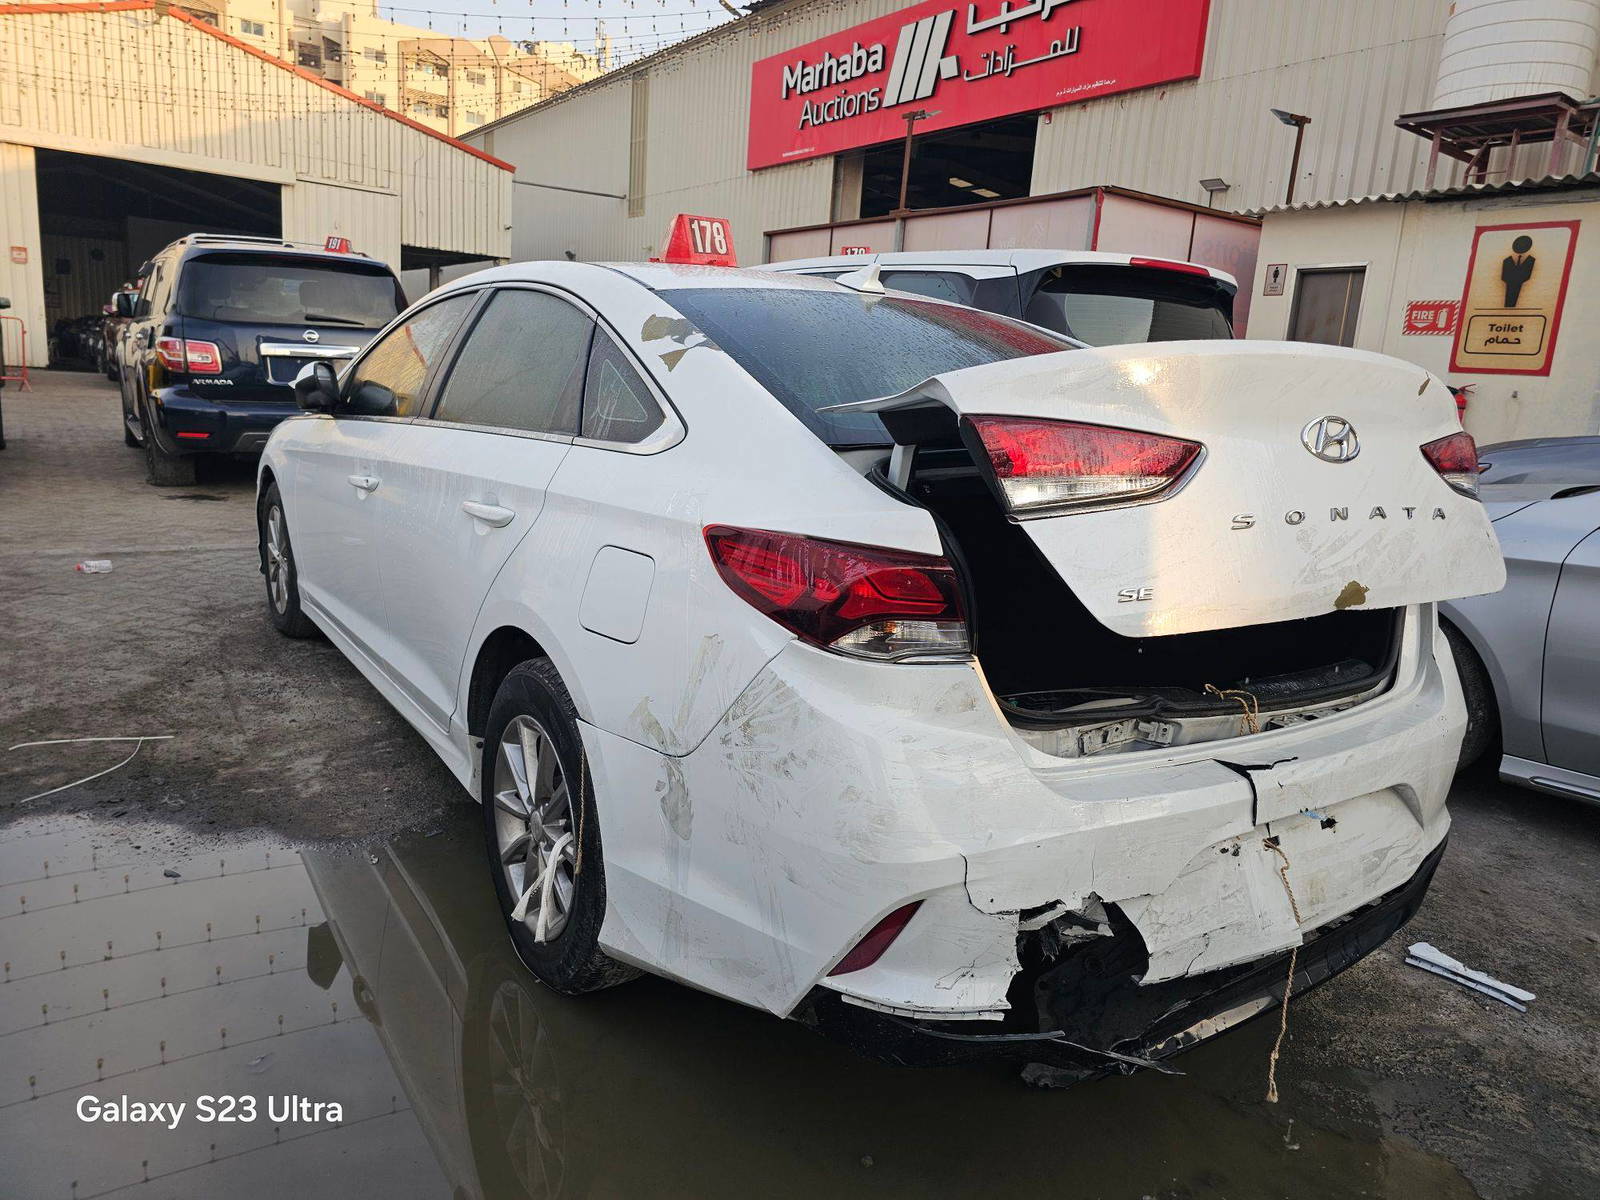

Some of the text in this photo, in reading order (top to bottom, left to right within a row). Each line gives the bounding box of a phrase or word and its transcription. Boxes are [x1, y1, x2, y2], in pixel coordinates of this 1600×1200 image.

[782, 42, 884, 99] Marhaba
[799, 87, 880, 129] Auctions
[328, 237, 341, 249] 191
[691, 219, 727, 254] 178
[1411, 310, 1435, 321] FIRE
[1488, 323, 1524, 333] Toilet
[1484, 335, 1522, 347] حمام
[191, 377, 234, 386] ARMADA
[1231, 506, 1447, 530] SONATA
[1117, 587, 1154, 603] SE
